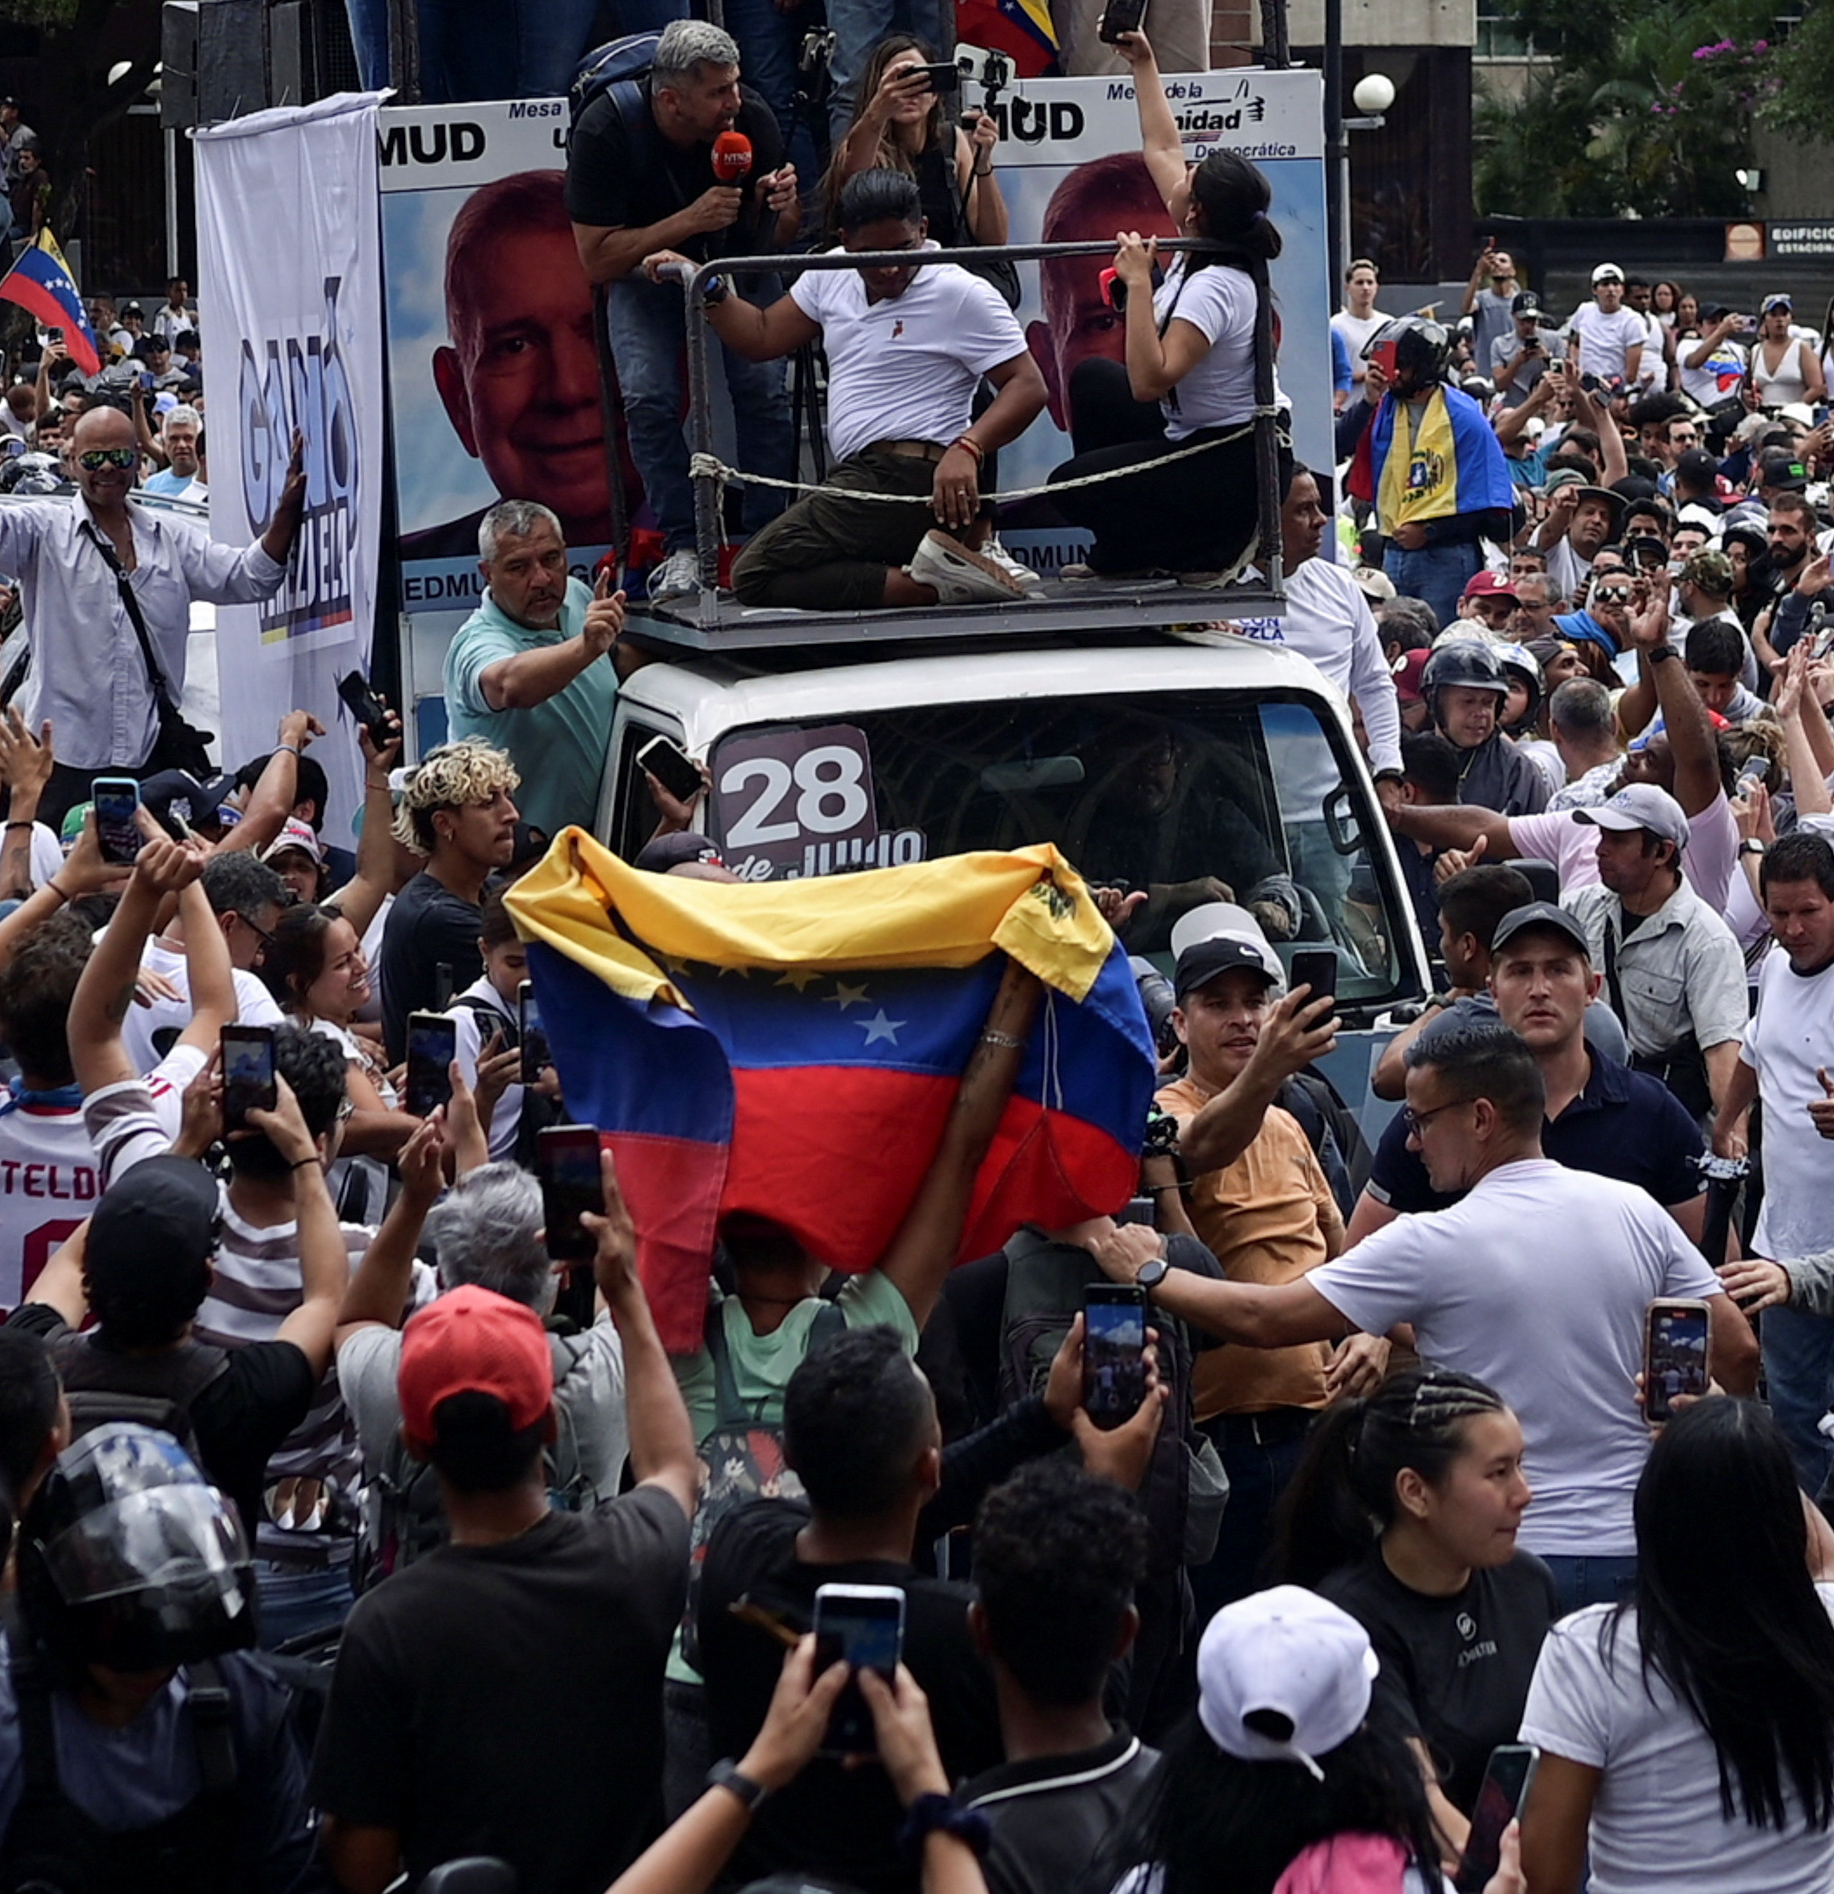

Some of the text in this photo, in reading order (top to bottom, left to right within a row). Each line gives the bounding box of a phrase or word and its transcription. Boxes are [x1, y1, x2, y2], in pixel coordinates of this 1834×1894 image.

[1165, 83, 1185, 98] de
[1188, 82, 1202, 98] la
[508, 102, 562, 119] Mesa
[1177, 109, 1241, 131] nidad
[378, 122, 486, 167] MUD
[1194, 142, 1296, 158] Democrática
[240, 277, 358, 540] GANÓ
[1012, 544, 1089, 567] DMUN
[405, 572, 483, 601] EDMU
[720, 745, 868, 849] 28
[730, 855, 773, 881] de
